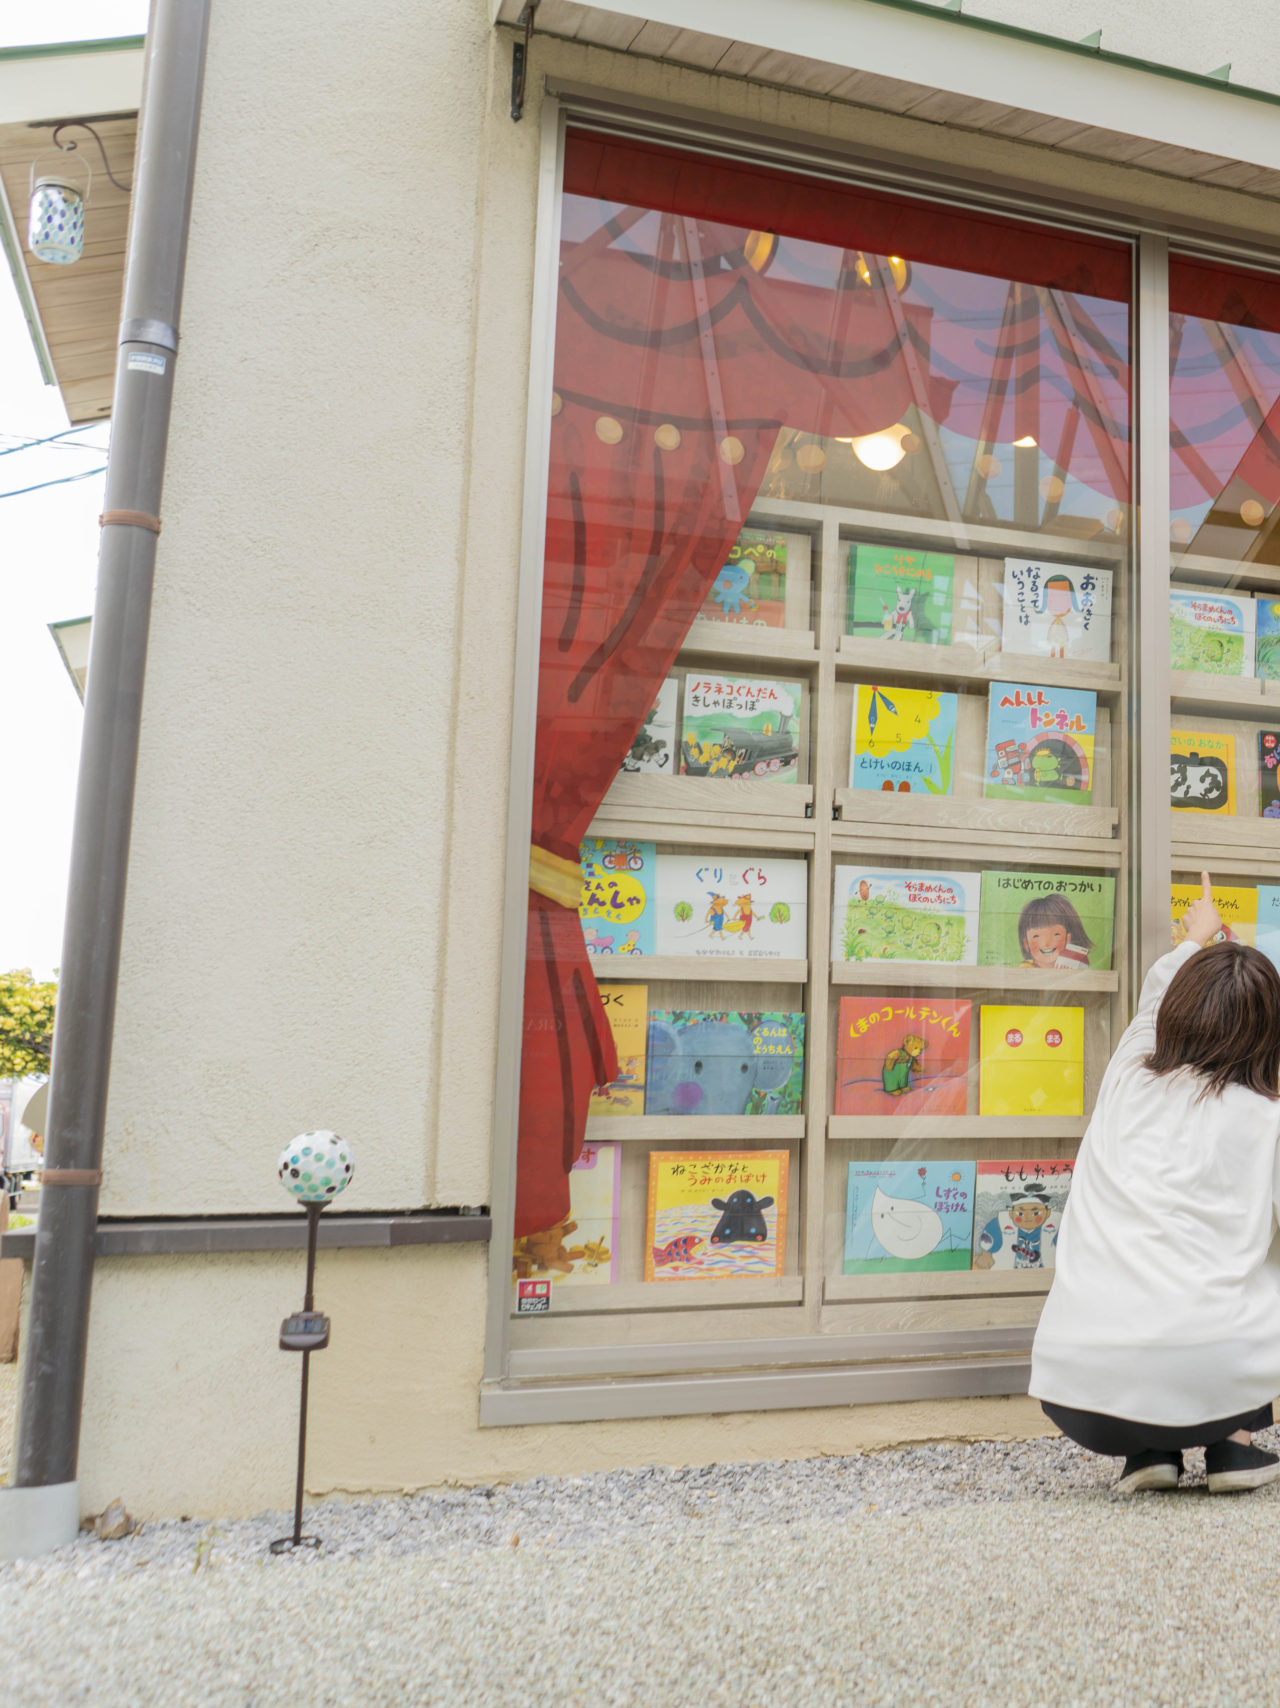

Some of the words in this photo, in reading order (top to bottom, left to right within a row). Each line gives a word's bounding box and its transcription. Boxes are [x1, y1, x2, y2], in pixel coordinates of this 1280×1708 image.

[1026, 566, 1041, 609] なるって
[1012, 569, 1031, 626] いうことは
[1080, 573, 1098, 631] おおきく
[691, 682, 778, 700] ノラネコぐんだん
[691, 694, 760, 711] きしゃぽっぽ
[1000, 690, 1050, 708] へんしん
[914, 714, 921, 724] 4
[1030, 707, 1087, 732] トンネル
[868, 739, 875, 748] 6
[896, 733, 902, 743] 5
[860, 758, 923, 773] とけいのほん
[905, 881, 953, 893] そらまめくんの
[998, 878, 1102, 893] はじめてのおつかい
[579, 890, 641, 909] んしゃ
[908, 893, 957, 905] ぼくのいちにち
[850, 1006, 961, 1038] くまのコールテンくん
[753, 1036, 763, 1044] の
[753, 1044, 793, 1055] ようちえん
[672, 1162, 749, 1175] ねこざかなと
[1001, 1164, 1073, 1182] ももたろう
[688, 1173, 767, 1187] うみのおばけ
[935, 1186, 968, 1200] しずくの
[934, 1201, 968, 1214] ぼうけん
